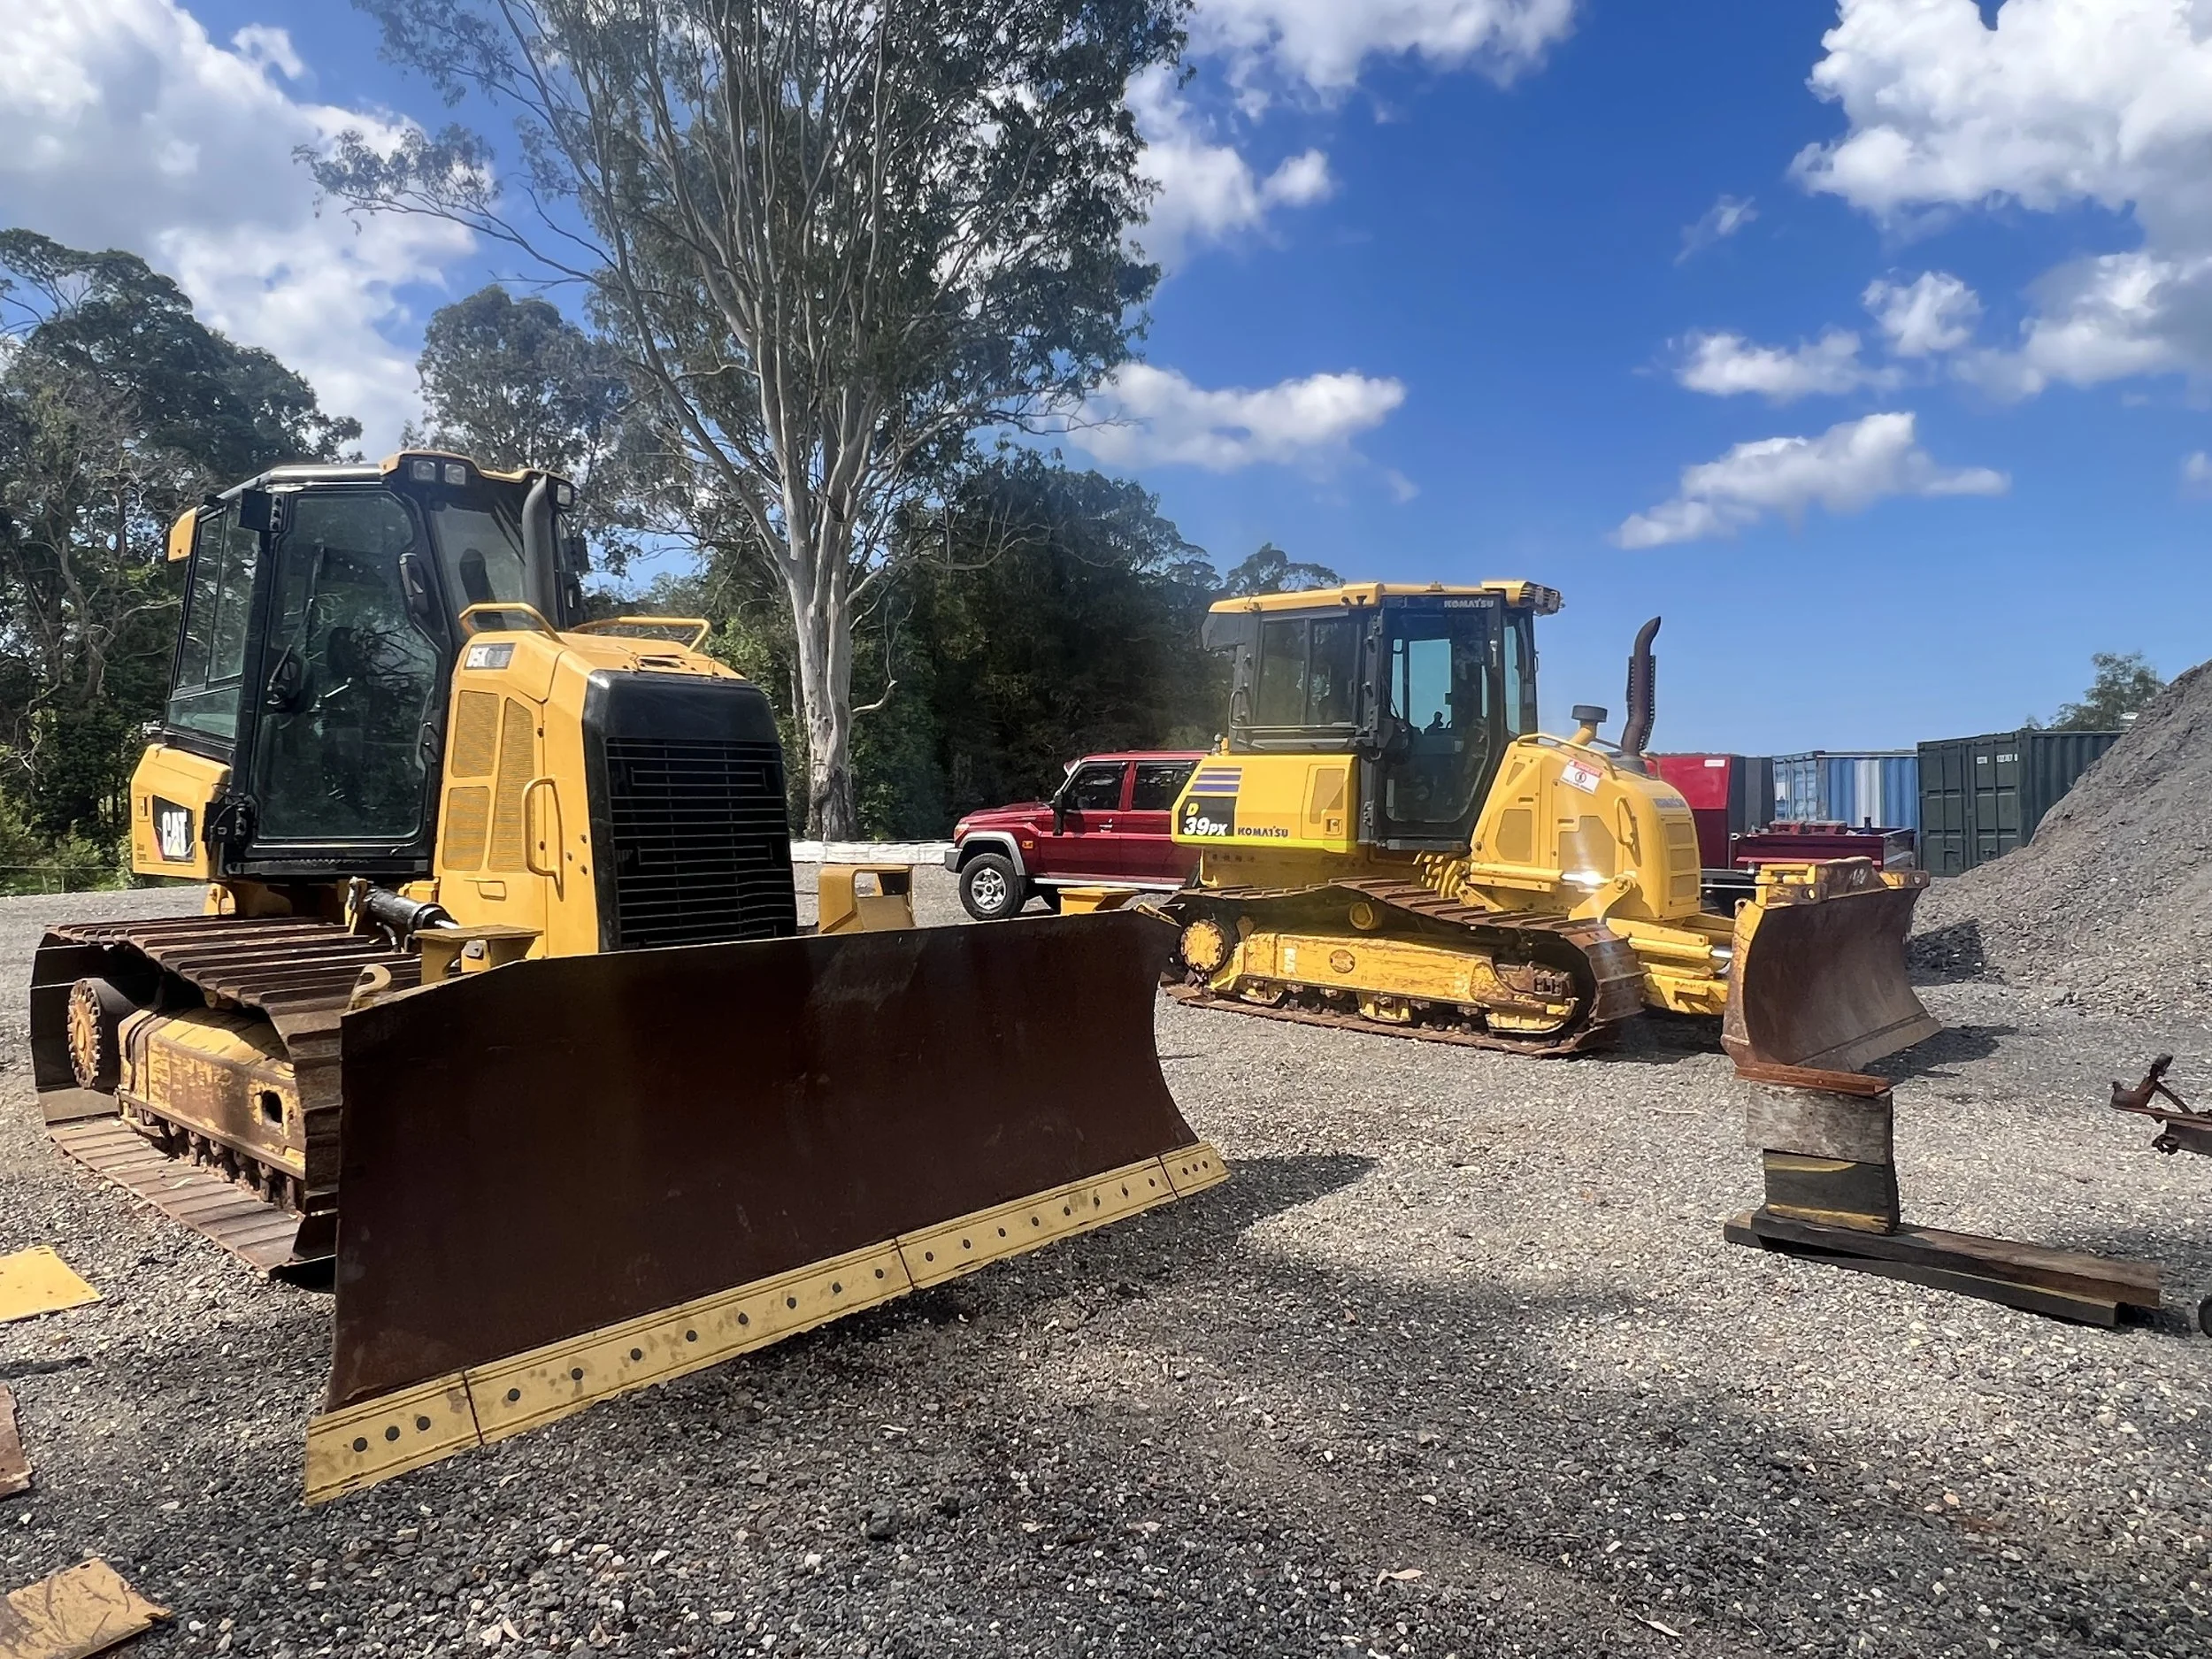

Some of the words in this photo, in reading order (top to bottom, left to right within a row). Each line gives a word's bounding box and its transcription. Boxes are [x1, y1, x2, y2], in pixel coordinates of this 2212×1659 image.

[1444, 598, 1494, 608] KOMATSU
[1187, 803, 1200, 817] D
[162, 810, 188, 856] CAT
[1183, 817, 1228, 836] 39PX
[1238, 826, 1289, 838] KOMATSU
